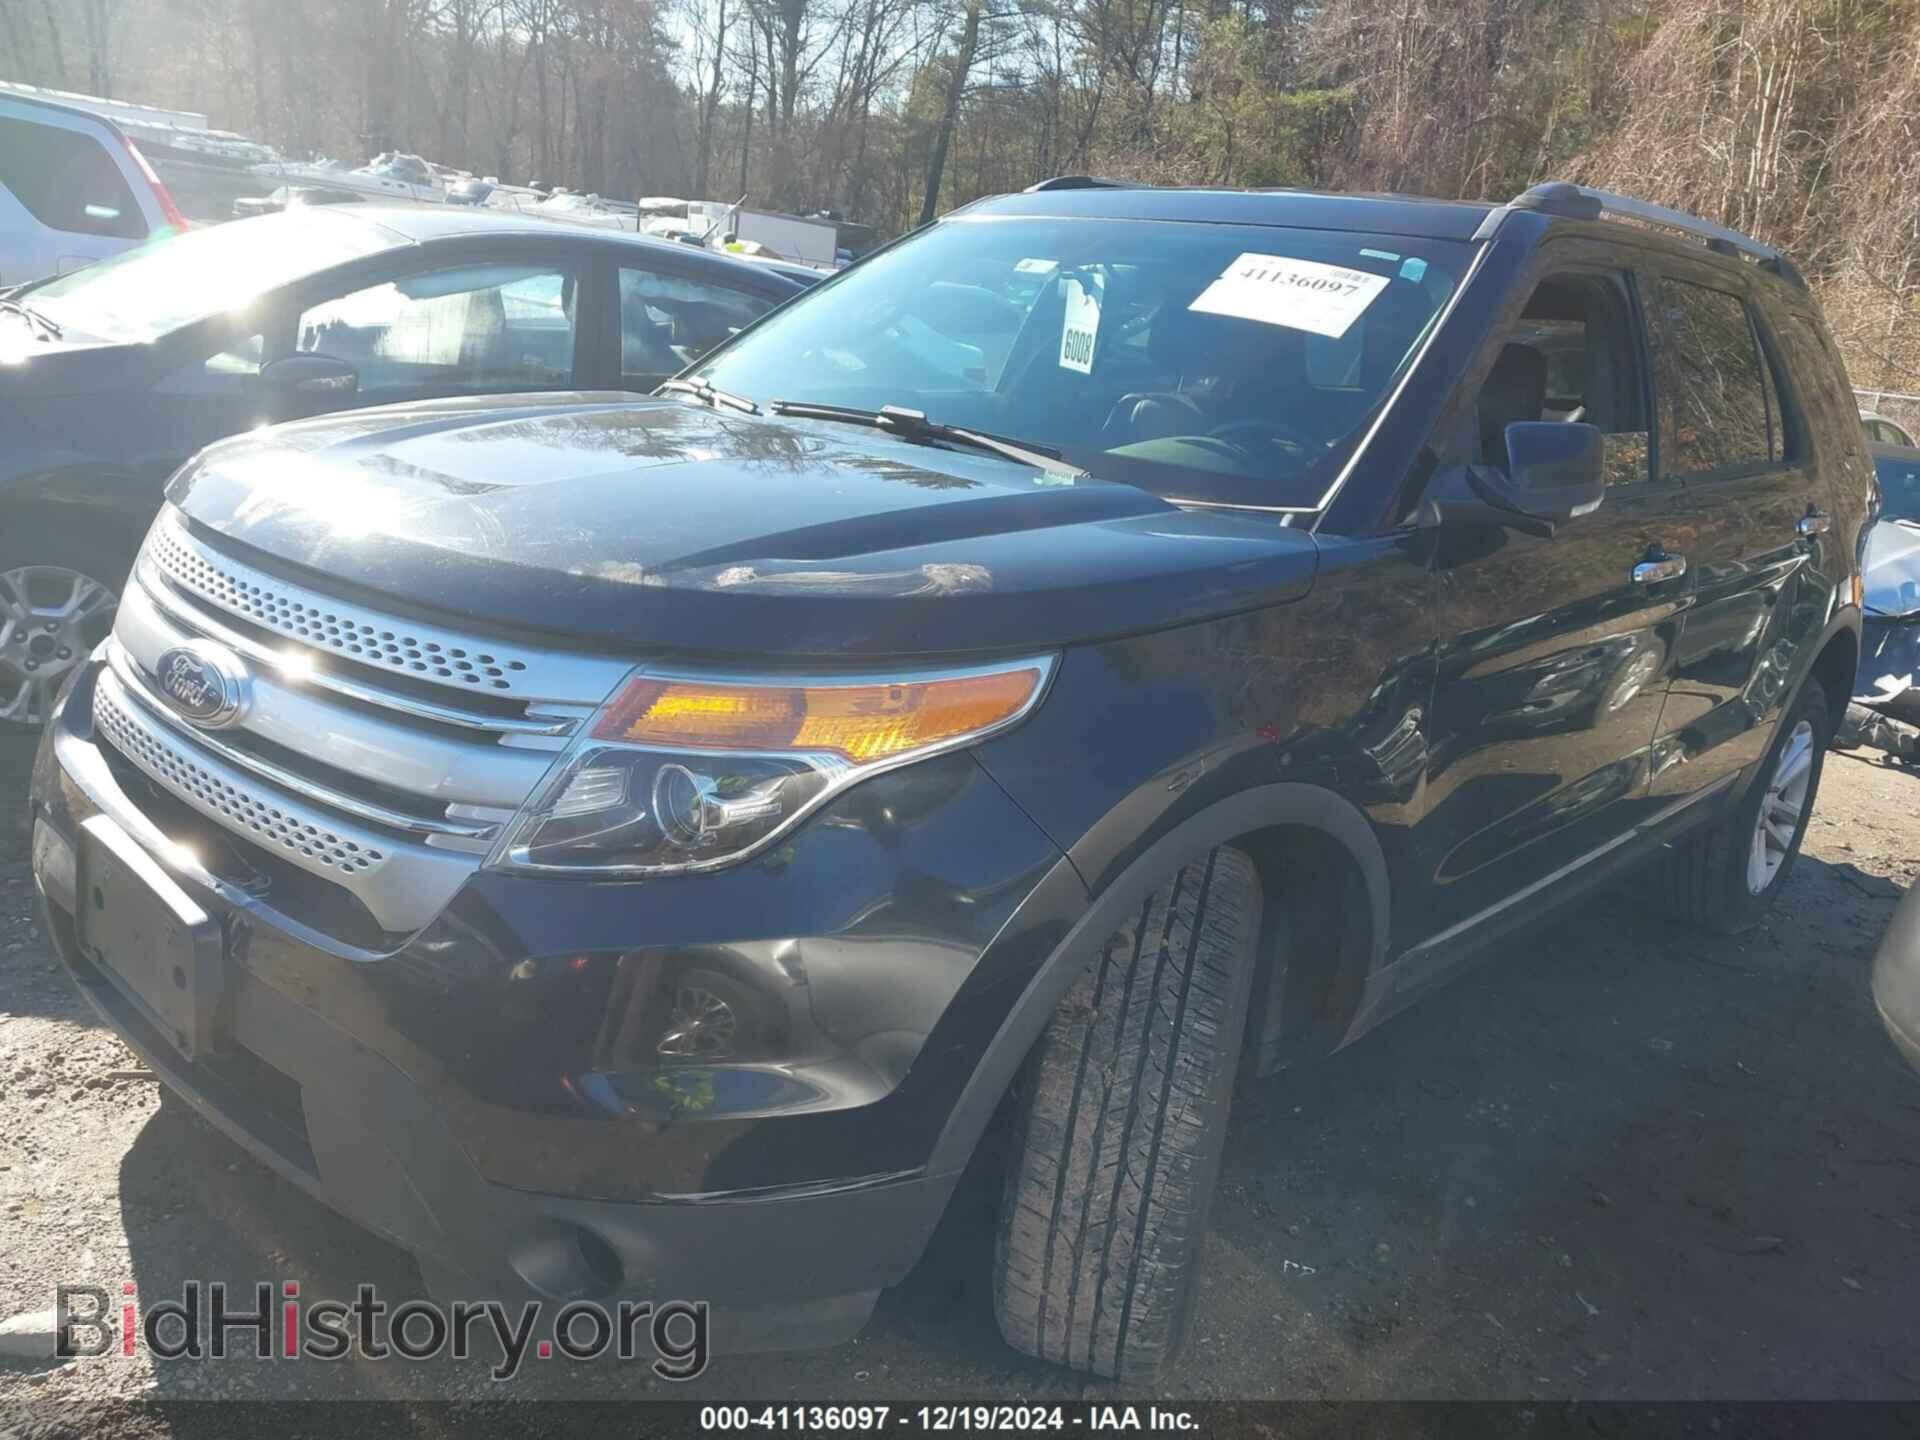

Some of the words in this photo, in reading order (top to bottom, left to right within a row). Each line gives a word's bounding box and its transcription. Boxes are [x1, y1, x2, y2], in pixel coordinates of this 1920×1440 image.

[1241, 268, 1359, 297] 41136097
[1064, 329, 1093, 365] 6008
[164, 655, 211, 707] Ford
